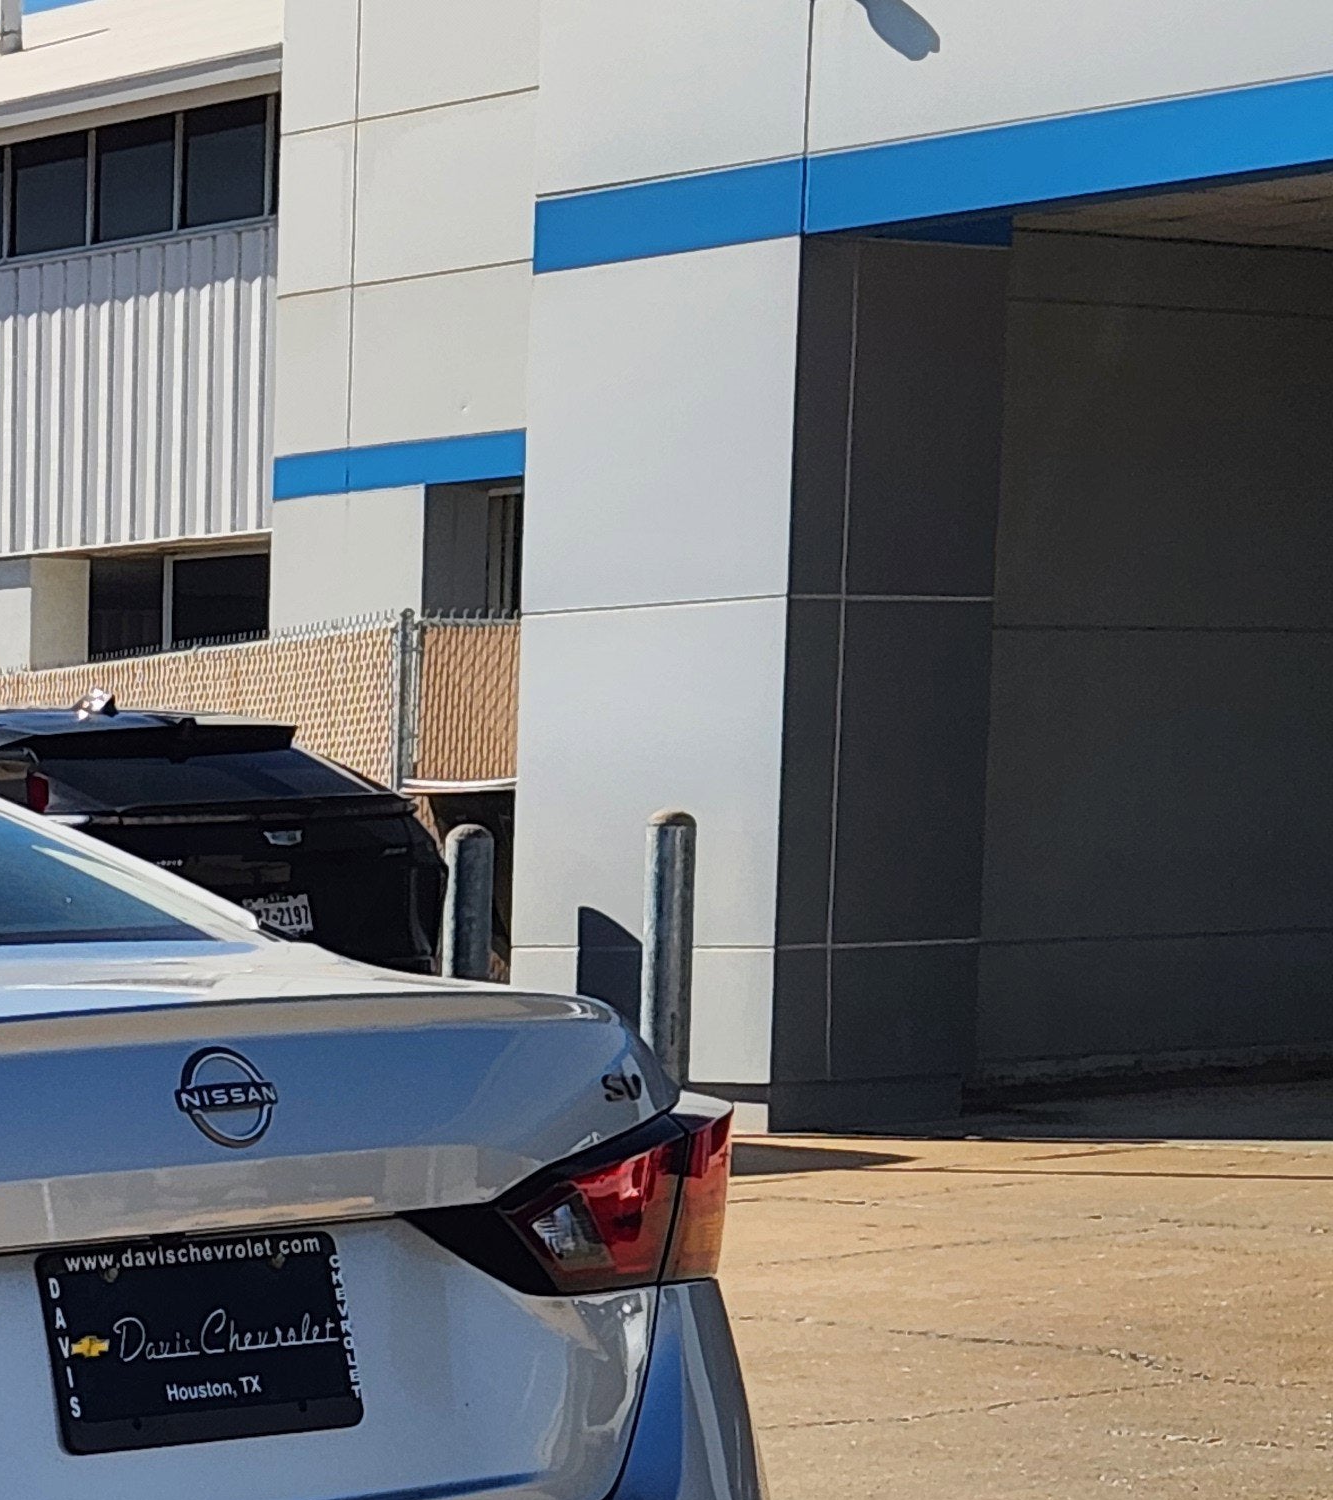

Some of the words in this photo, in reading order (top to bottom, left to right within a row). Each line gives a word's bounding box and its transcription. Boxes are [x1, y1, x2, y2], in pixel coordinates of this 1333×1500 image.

[180, 1085, 276, 1108] NISSAN
[601, 1072, 641, 1102] SV
[64, 1236, 321, 1272] www.davischevroletcom
[113, 1317, 200, 1362] Davis
[200, 1308, 340, 1352] Chevrolet
[329, 1254, 362, 1399] CHEVROLET
[48, 1277, 81, 1418] DAVIS
[166, 1381, 237, 1402] Houston,
[239, 1375, 262, 1394] TX
